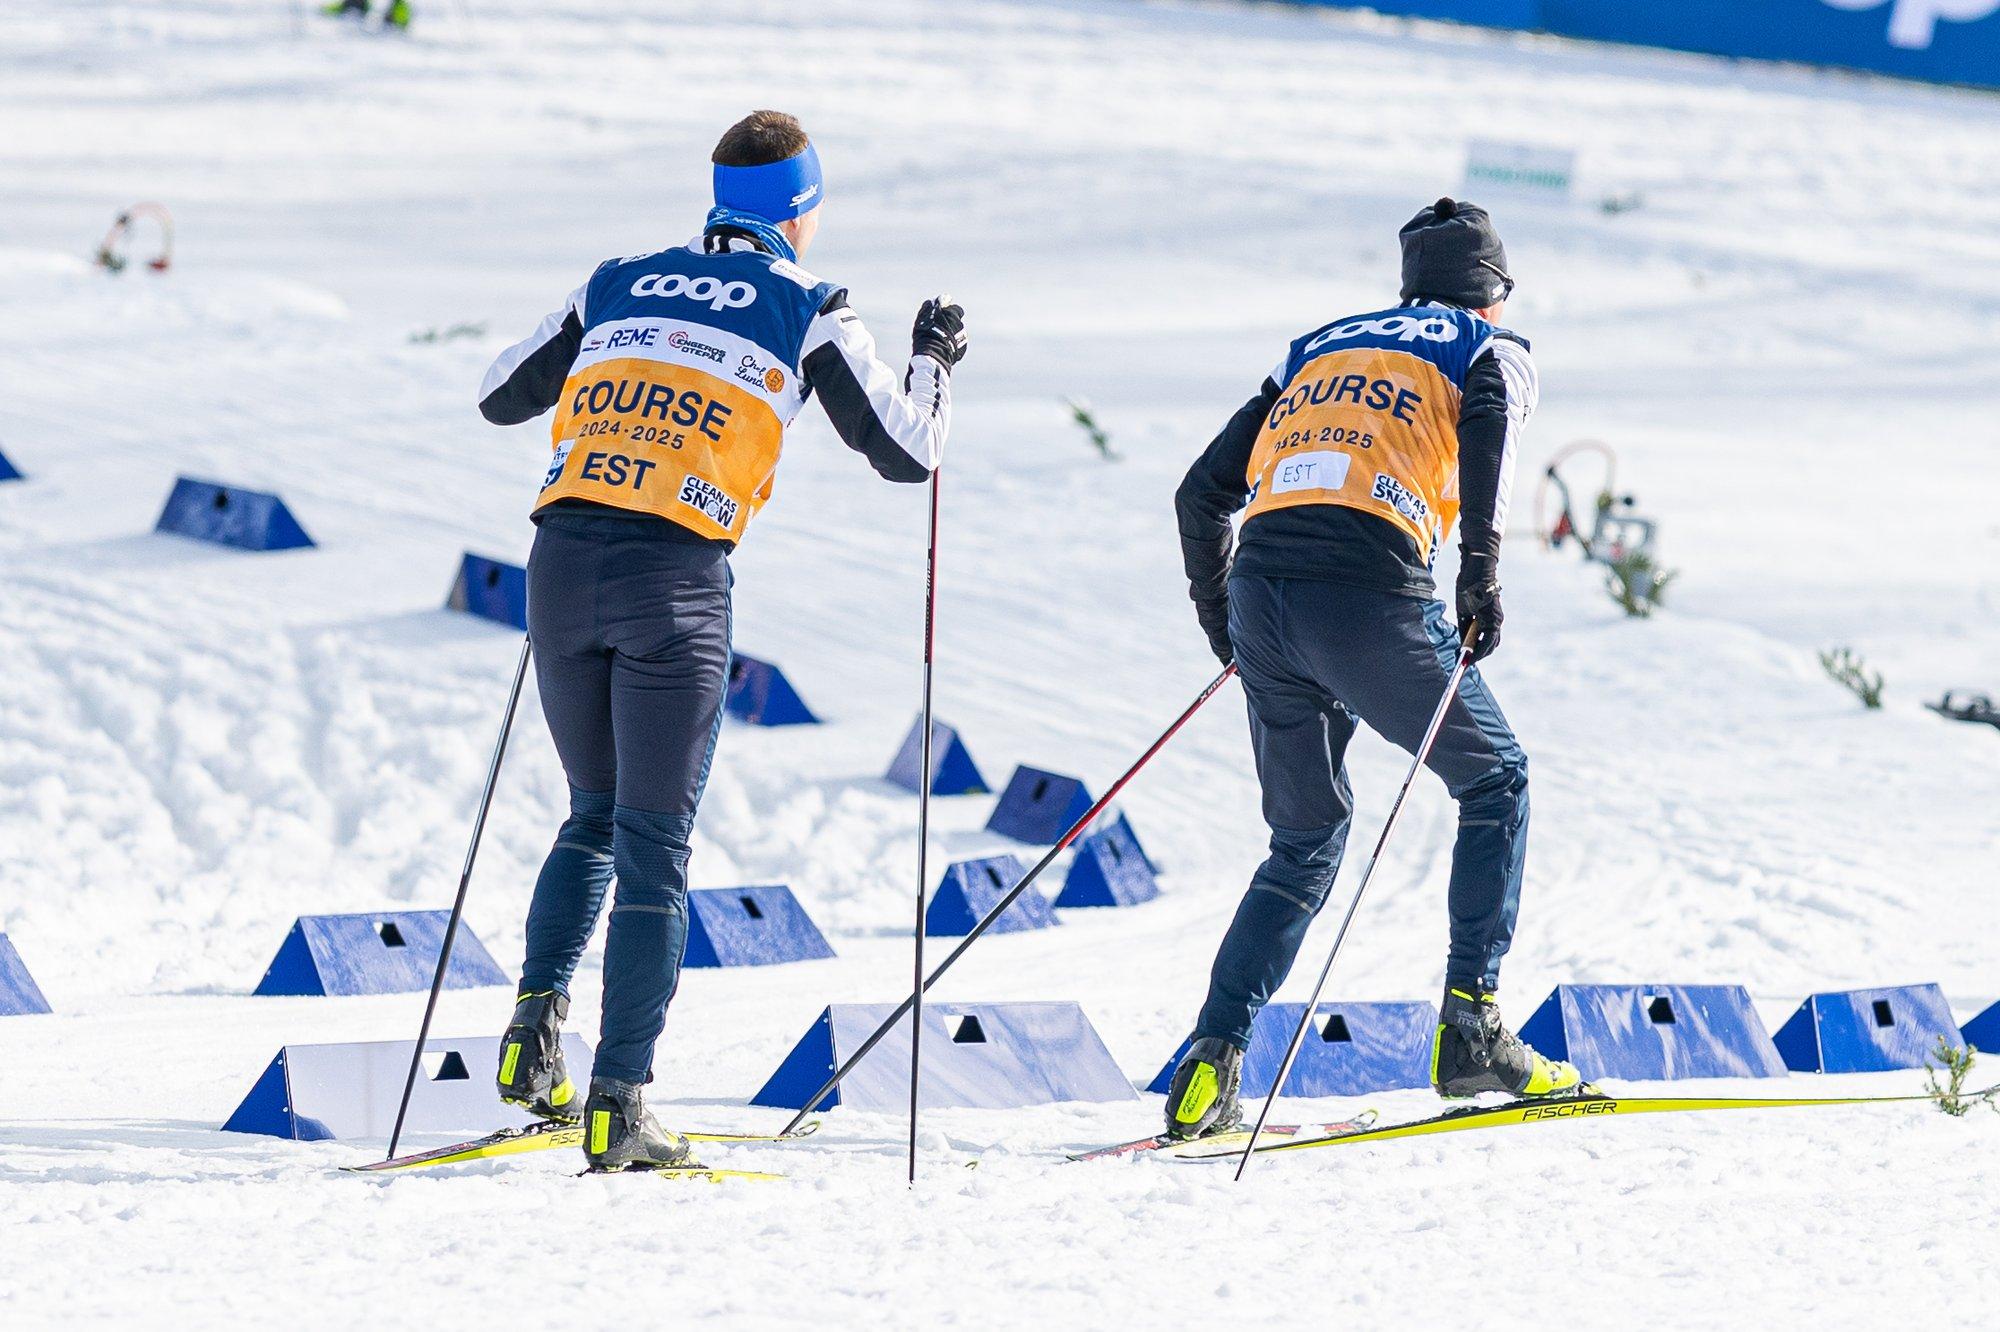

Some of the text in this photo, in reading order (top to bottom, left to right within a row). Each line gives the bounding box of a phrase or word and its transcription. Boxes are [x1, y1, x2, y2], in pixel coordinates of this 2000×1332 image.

[630, 274, 757, 311] coop
[607, 327, 659, 349] REME
[1304, 315, 1459, 354] coop
[573, 379, 733, 442] COURSE
[1269, 374, 1423, 428] COURSE
[580, 452, 656, 490] EST
[1283, 463, 1317, 483] EST
[680, 487, 733, 528] SNOW
[687, 476, 737, 513] CLEAN AS
[1413, 499, 1426, 515] AS
[1522, 1101, 1618, 1121] FISCHER
